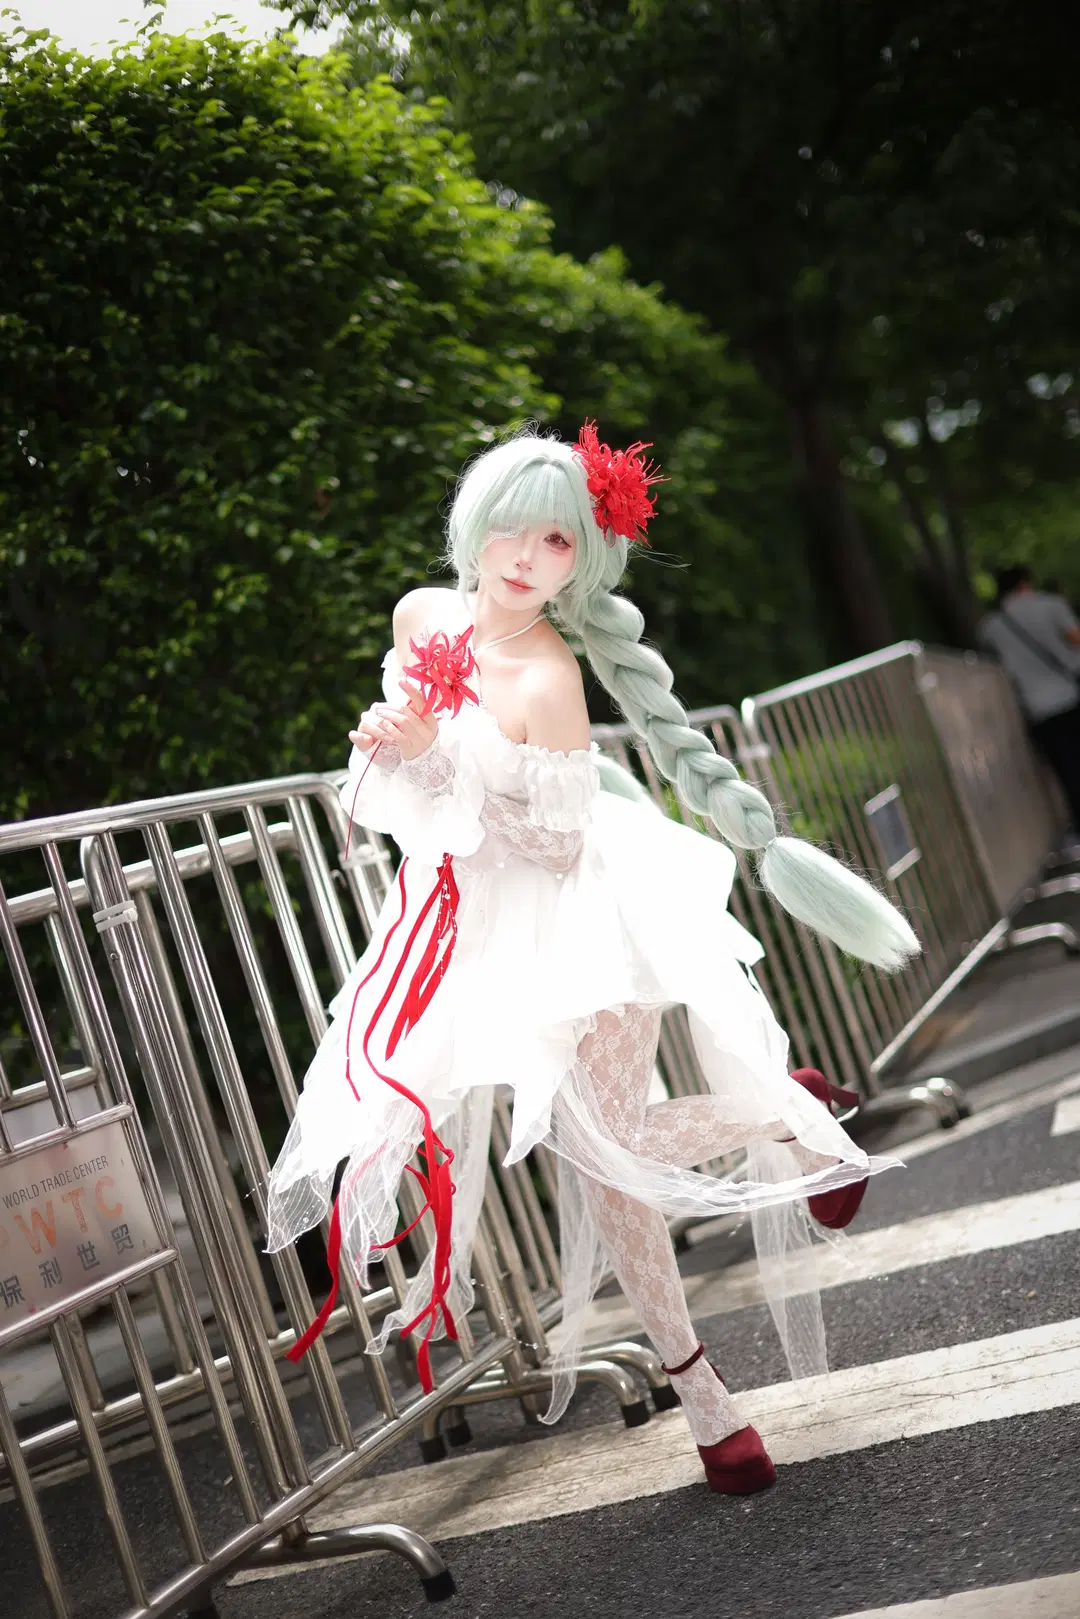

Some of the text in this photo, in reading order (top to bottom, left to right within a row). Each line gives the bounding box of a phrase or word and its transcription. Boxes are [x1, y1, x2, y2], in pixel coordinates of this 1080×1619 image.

[3, 1155, 109, 1209] WORLD TRADE CENTER
[0, 1223, 134, 1307] 保利世贸
